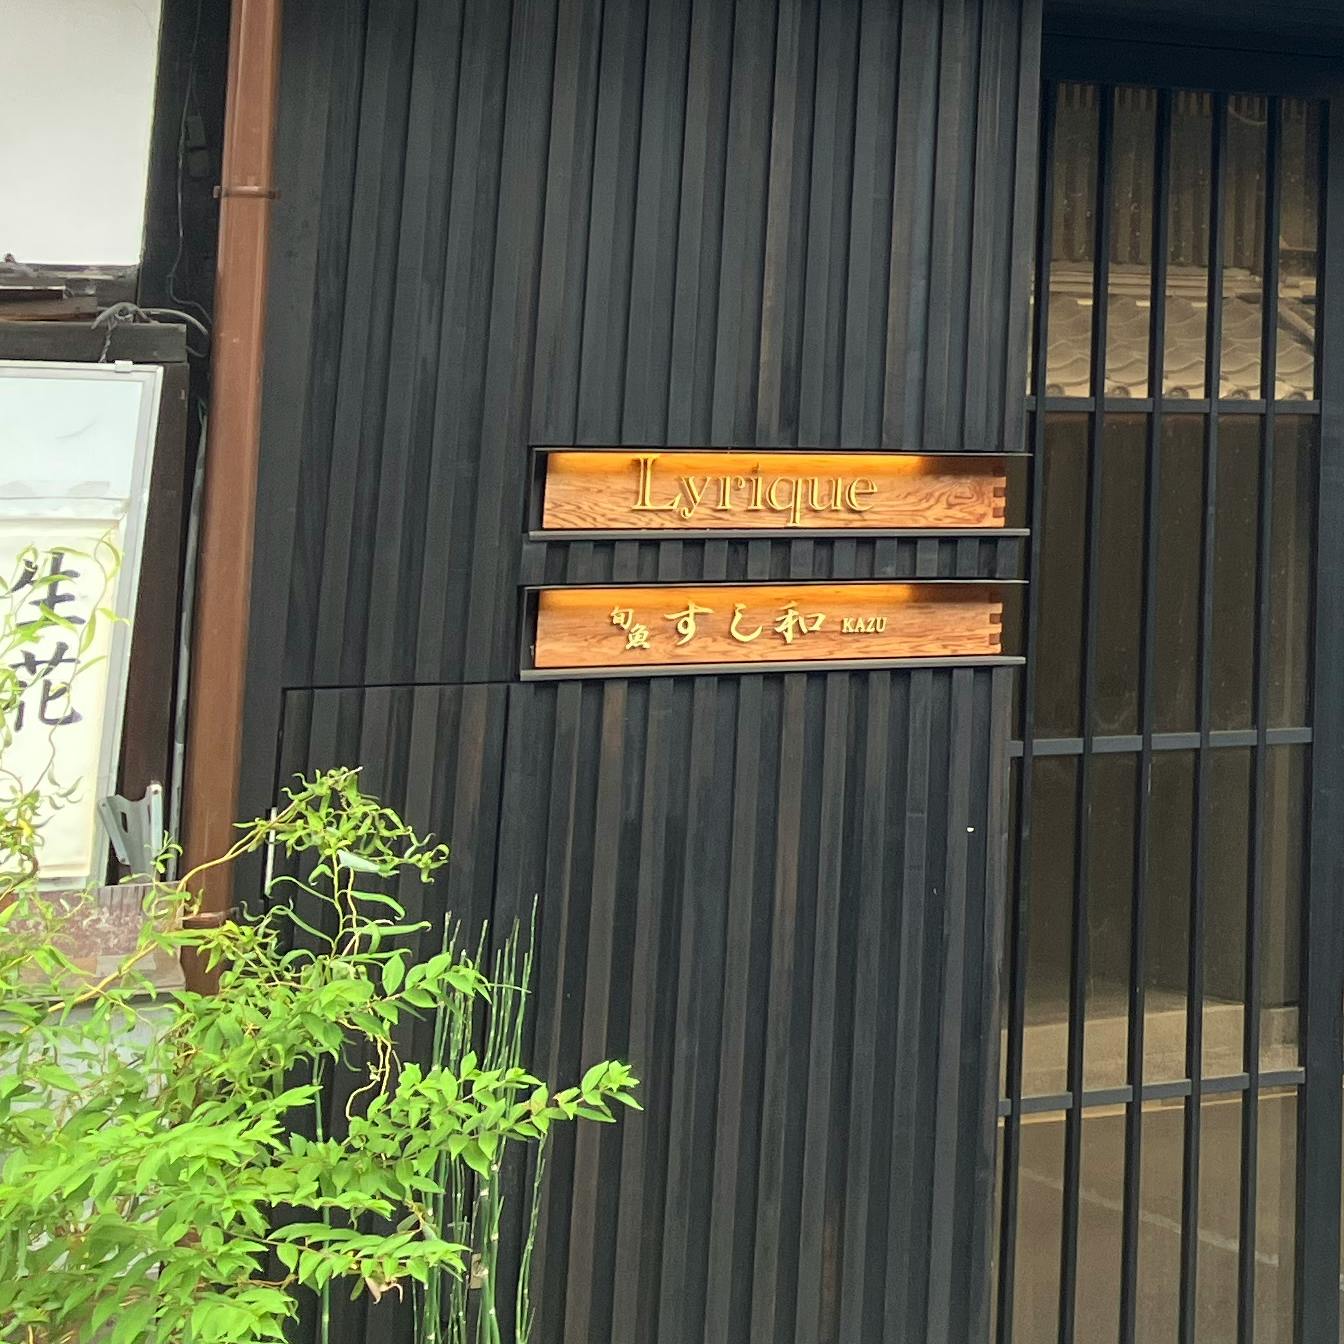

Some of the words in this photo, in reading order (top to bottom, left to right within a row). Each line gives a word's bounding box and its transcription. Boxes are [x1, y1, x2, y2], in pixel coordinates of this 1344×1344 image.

[632, 456, 878, 526] Lyrique
[9, 551, 86, 732] 生花
[841, 617, 888, 633] KAZU
